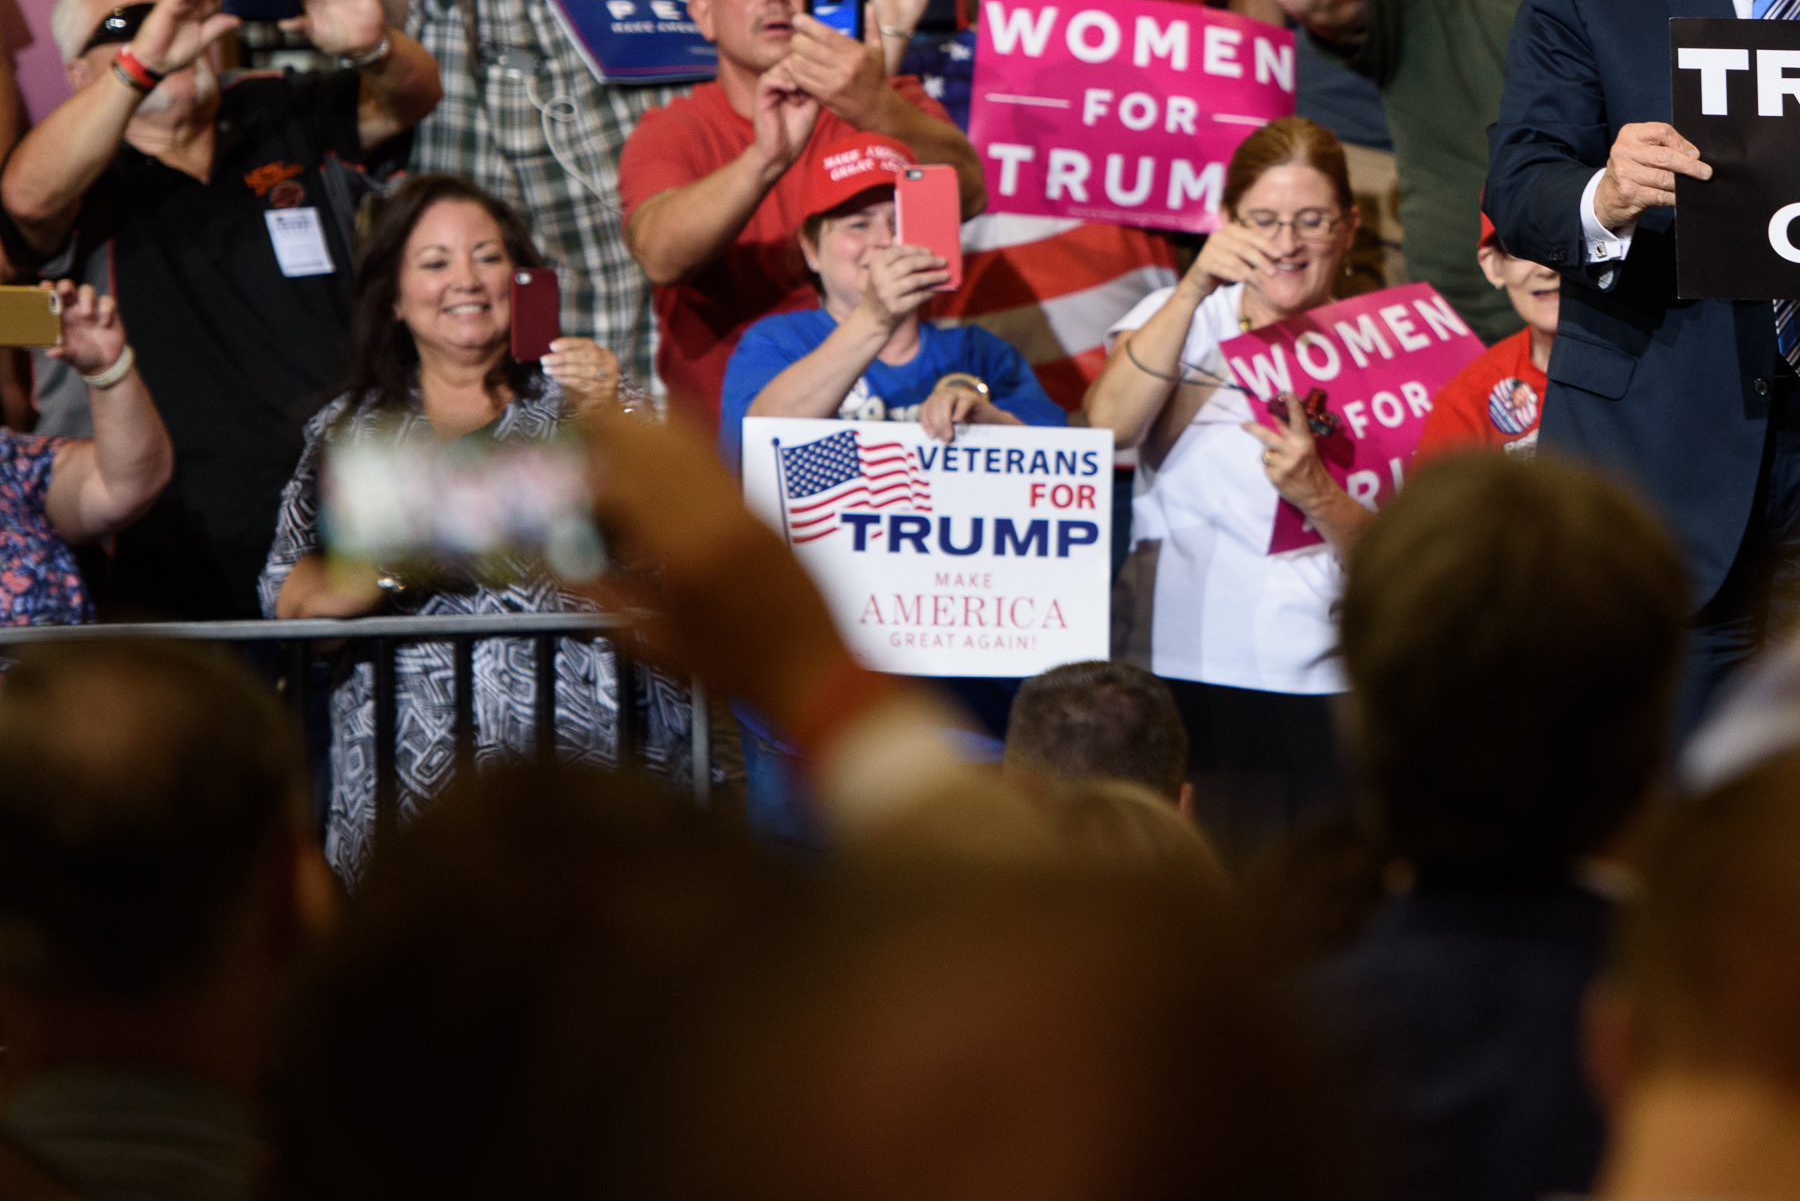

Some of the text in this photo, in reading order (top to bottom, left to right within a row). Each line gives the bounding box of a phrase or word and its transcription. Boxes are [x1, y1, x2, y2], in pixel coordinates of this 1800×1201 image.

[985, 0, 1295, 94] WOMEN
[1082, 88, 1197, 135] FOR
[987, 142, 1226, 214] TRUM
[1230, 295, 1469, 403] WOMEN
[1342, 380, 1433, 440] FOR
[917, 445, 1099, 476] VETERANS
[1029, 483, 1096, 510] FOR
[841, 513, 1099, 558] TRUMP
[934, 572, 993, 589] MAKE
[859, 594, 1069, 630] AMERICA
[889, 632, 1037, 650] GREAT AGAIN!
